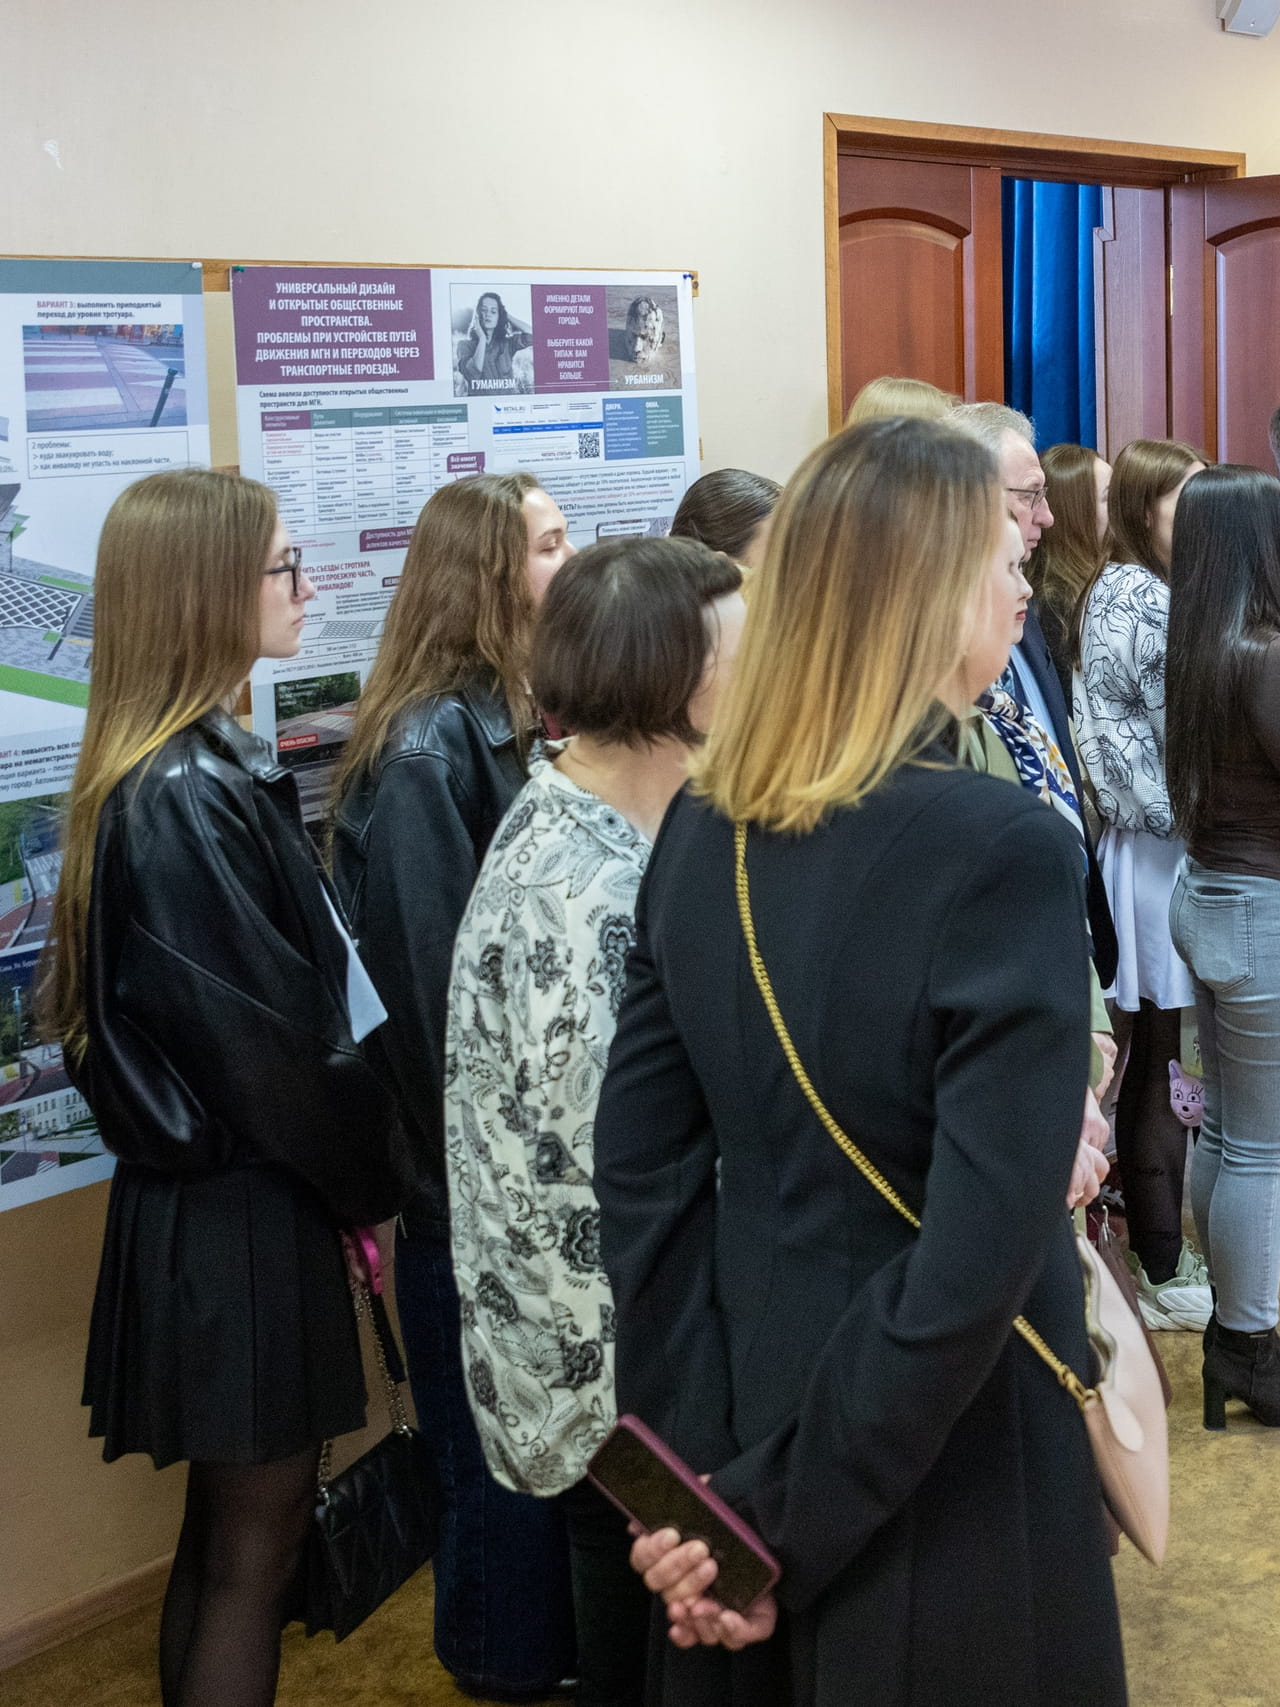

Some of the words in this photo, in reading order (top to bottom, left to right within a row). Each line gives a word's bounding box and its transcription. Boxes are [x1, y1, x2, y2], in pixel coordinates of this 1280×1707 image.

[276, 282, 357, 295] УНИВЕРСАЛЬНЫЙ
[359, 282, 395, 296] ДИЗАЙН
[570, 295, 591, 304] ДЕТАЛИ
[269, 300, 276, 310] И
[278, 300, 329, 310] ОТКРЫТЫЕ
[330, 299, 403, 312] ОБЩЕСТВЕННЫЕ
[301, 316, 372, 326] ПРОСТРАНСТВА.
[257, 332, 311, 344] ПРОБЛЕМЫ
[313, 332, 331, 343] ПРИ
[333, 330, 388, 343] УСТРОЙСТВЕ
[389, 330, 416, 342] ПУТЕЙ
[547, 339, 575, 347] ВЫБЕРИТЕ
[575, 338, 593, 346] КАКОЙ
[255, 349, 309, 362] ДВИЖЕНИЯ
[311, 349, 330, 360] МГН
[332, 349, 339, 359] И
[341, 348, 392, 360] ПЕРЕХОДОВ
[393, 347, 419, 358] ЧЕРЕЗ
[280, 364, 352, 376] ТРАНСПОРТНЫЕ
[354, 364, 400, 375] ПРОЕЗДЫ.
[471, 380, 516, 390] ГУМАНИЗМ
[624, 374, 664, 385] УРБАНИЗМ
